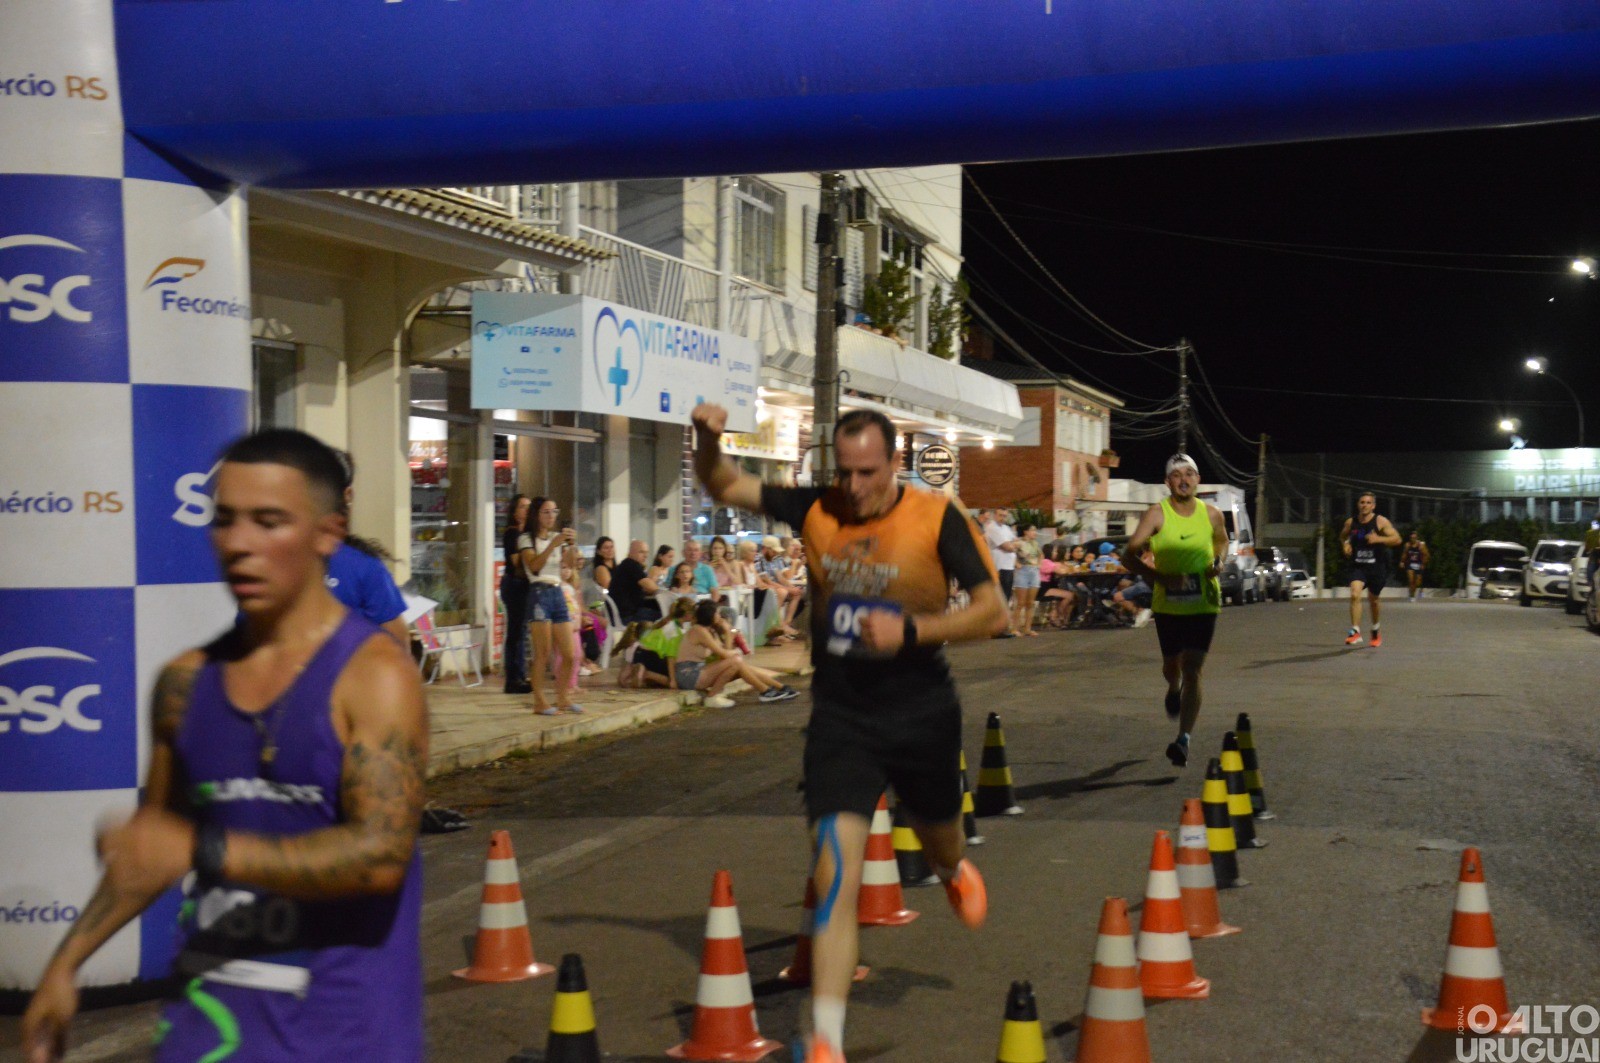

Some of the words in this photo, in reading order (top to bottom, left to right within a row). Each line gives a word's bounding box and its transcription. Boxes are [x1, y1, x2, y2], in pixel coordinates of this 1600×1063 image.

[65, 75, 108, 100] RS
[503, 325, 576, 338] VITAFARMA
[641, 317, 721, 366] VITAFARMA
[83, 490, 124, 514] RS
